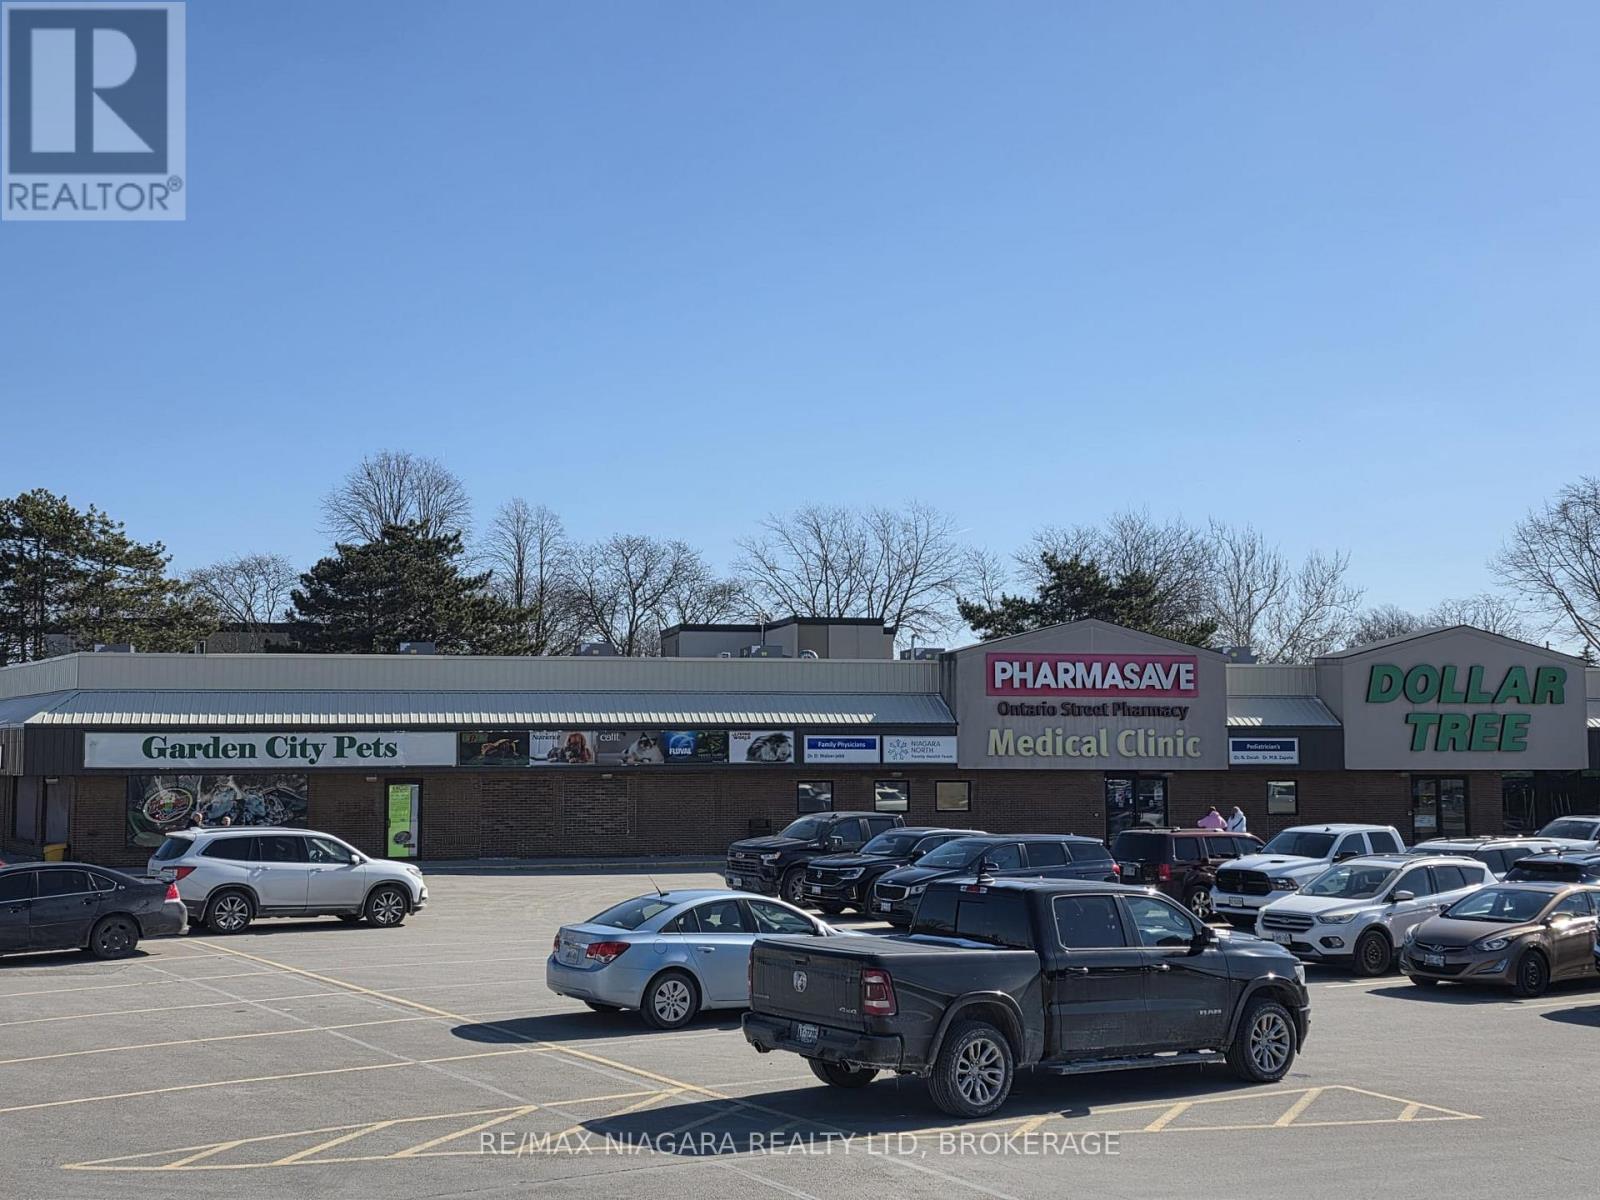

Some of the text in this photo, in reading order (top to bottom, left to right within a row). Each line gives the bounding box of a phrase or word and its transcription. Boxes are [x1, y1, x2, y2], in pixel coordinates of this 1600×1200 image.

[994, 661, 1195, 691] PHARMASAVE
[1366, 664, 1567, 704] DOLLAR
[997, 702, 1190, 721] Ontario Street Pharmacy
[817, 740, 866, 749] Family Physicians
[986, 727, 1202, 758] Medical Clinic
[1405, 712, 1531, 752] TREE
[142, 734, 398, 765] Garden City Pets
